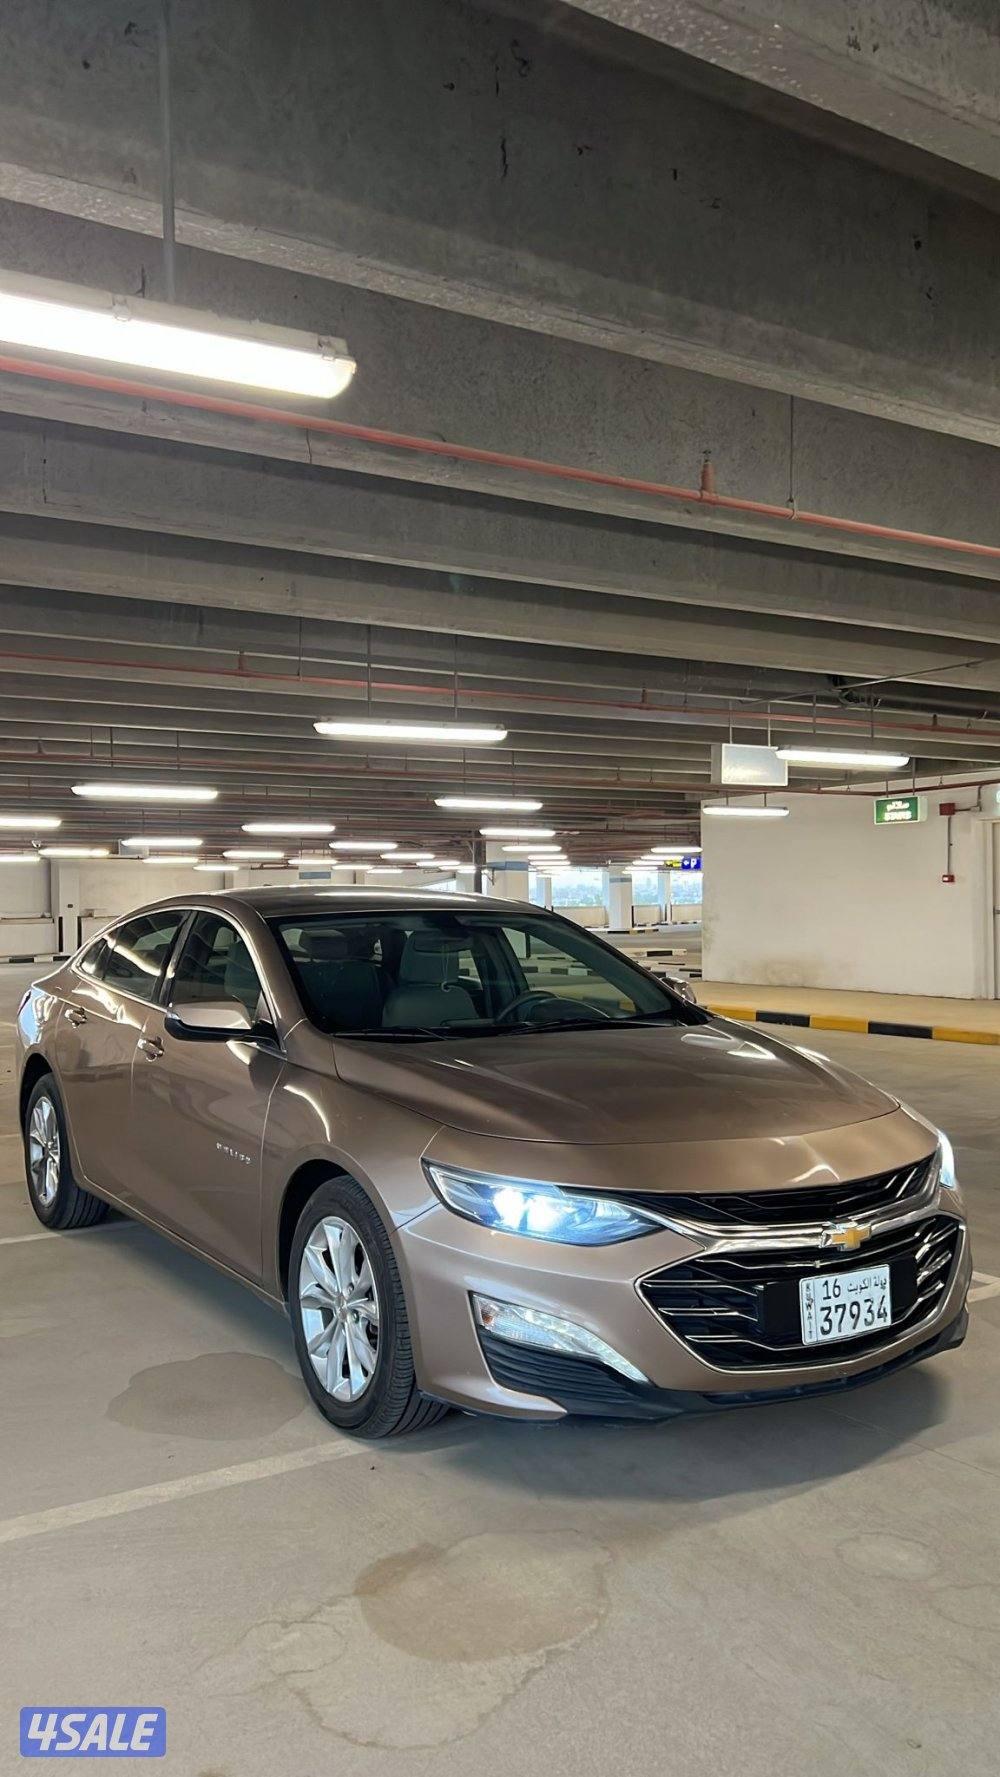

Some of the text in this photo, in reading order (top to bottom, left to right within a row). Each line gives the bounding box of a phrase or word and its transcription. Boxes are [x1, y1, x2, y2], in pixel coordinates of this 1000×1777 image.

[822, 1278, 841, 1300] 16
[847, 1276, 872, 1294] الكويت
[820, 1295, 888, 1336] 37934
